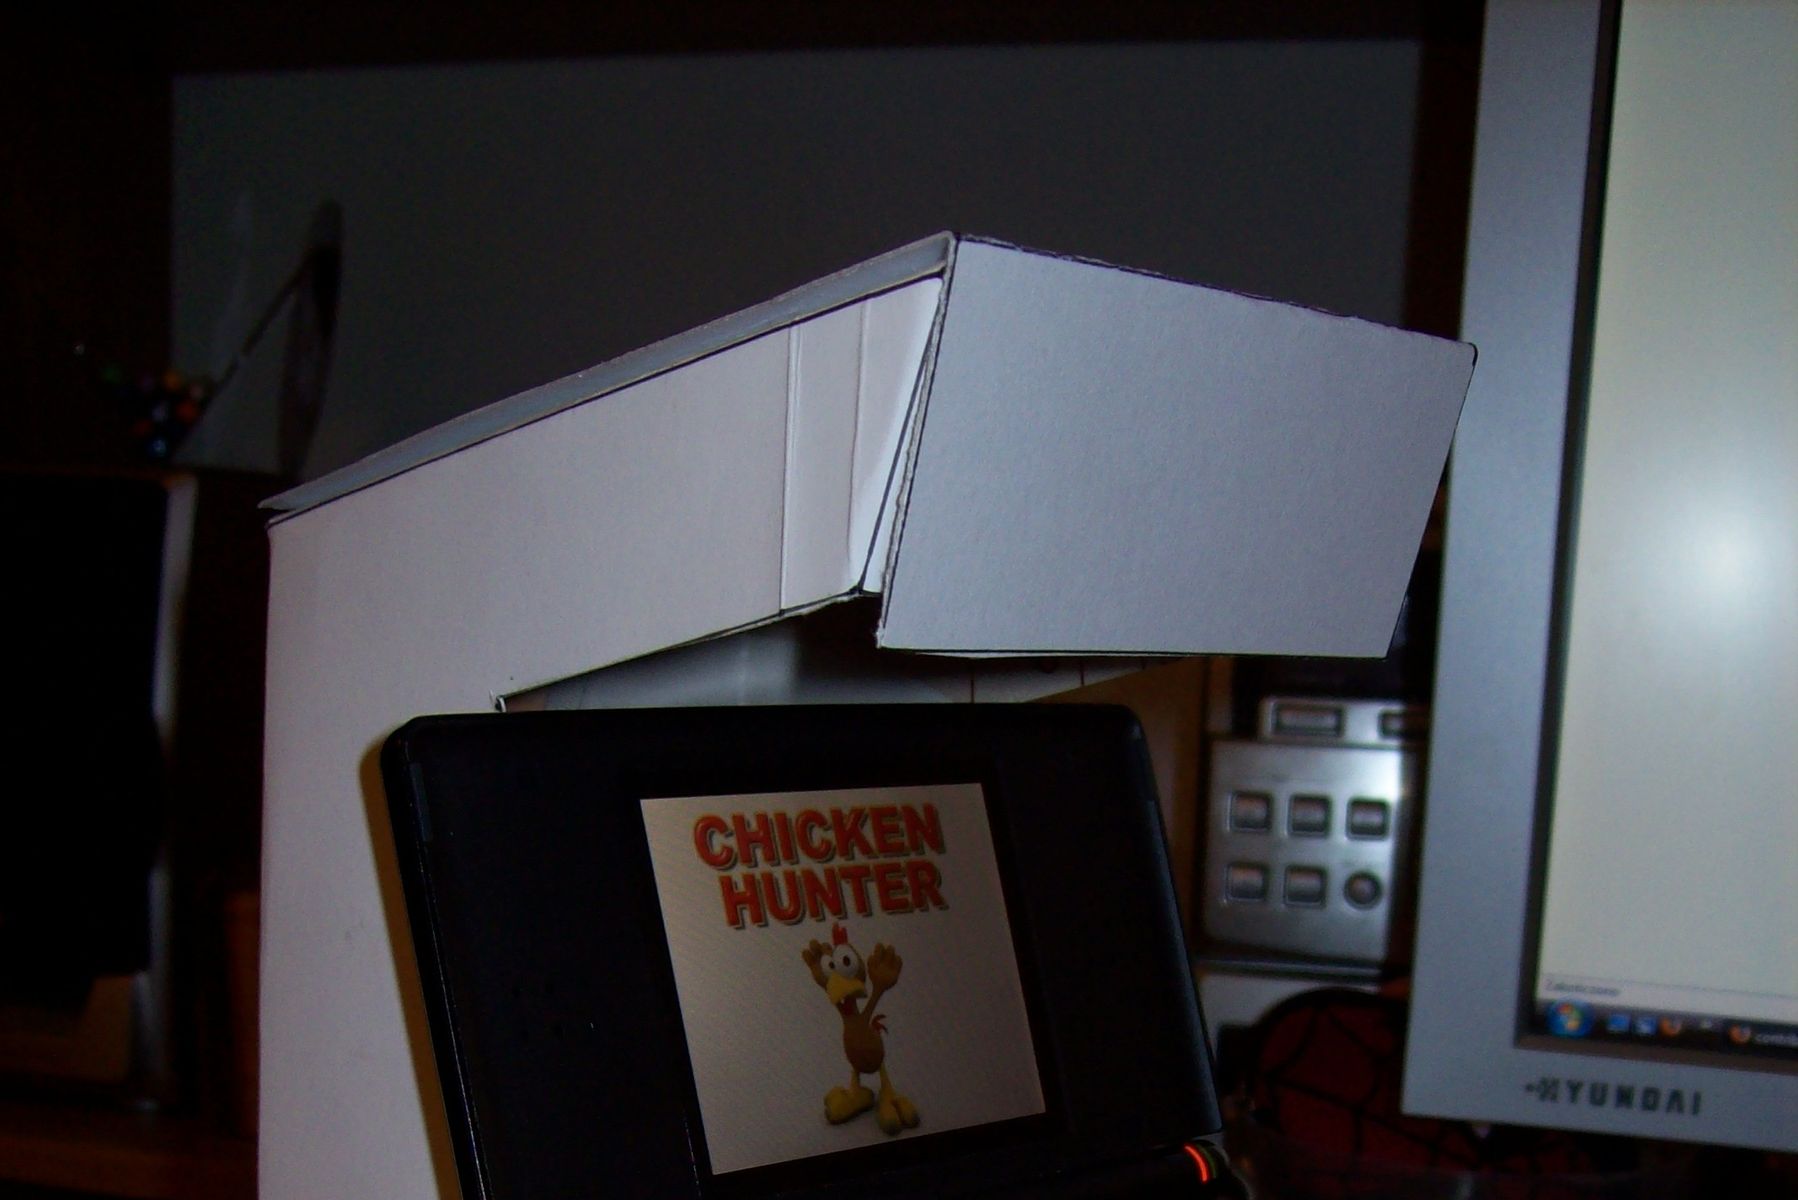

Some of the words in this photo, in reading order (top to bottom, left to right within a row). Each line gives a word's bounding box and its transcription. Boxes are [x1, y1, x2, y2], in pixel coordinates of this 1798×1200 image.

[694, 803, 946, 869] CHICKEN
[718, 859, 949, 930] HUNTER
[1525, 1077, 1702, 1116] HYUNDAI
